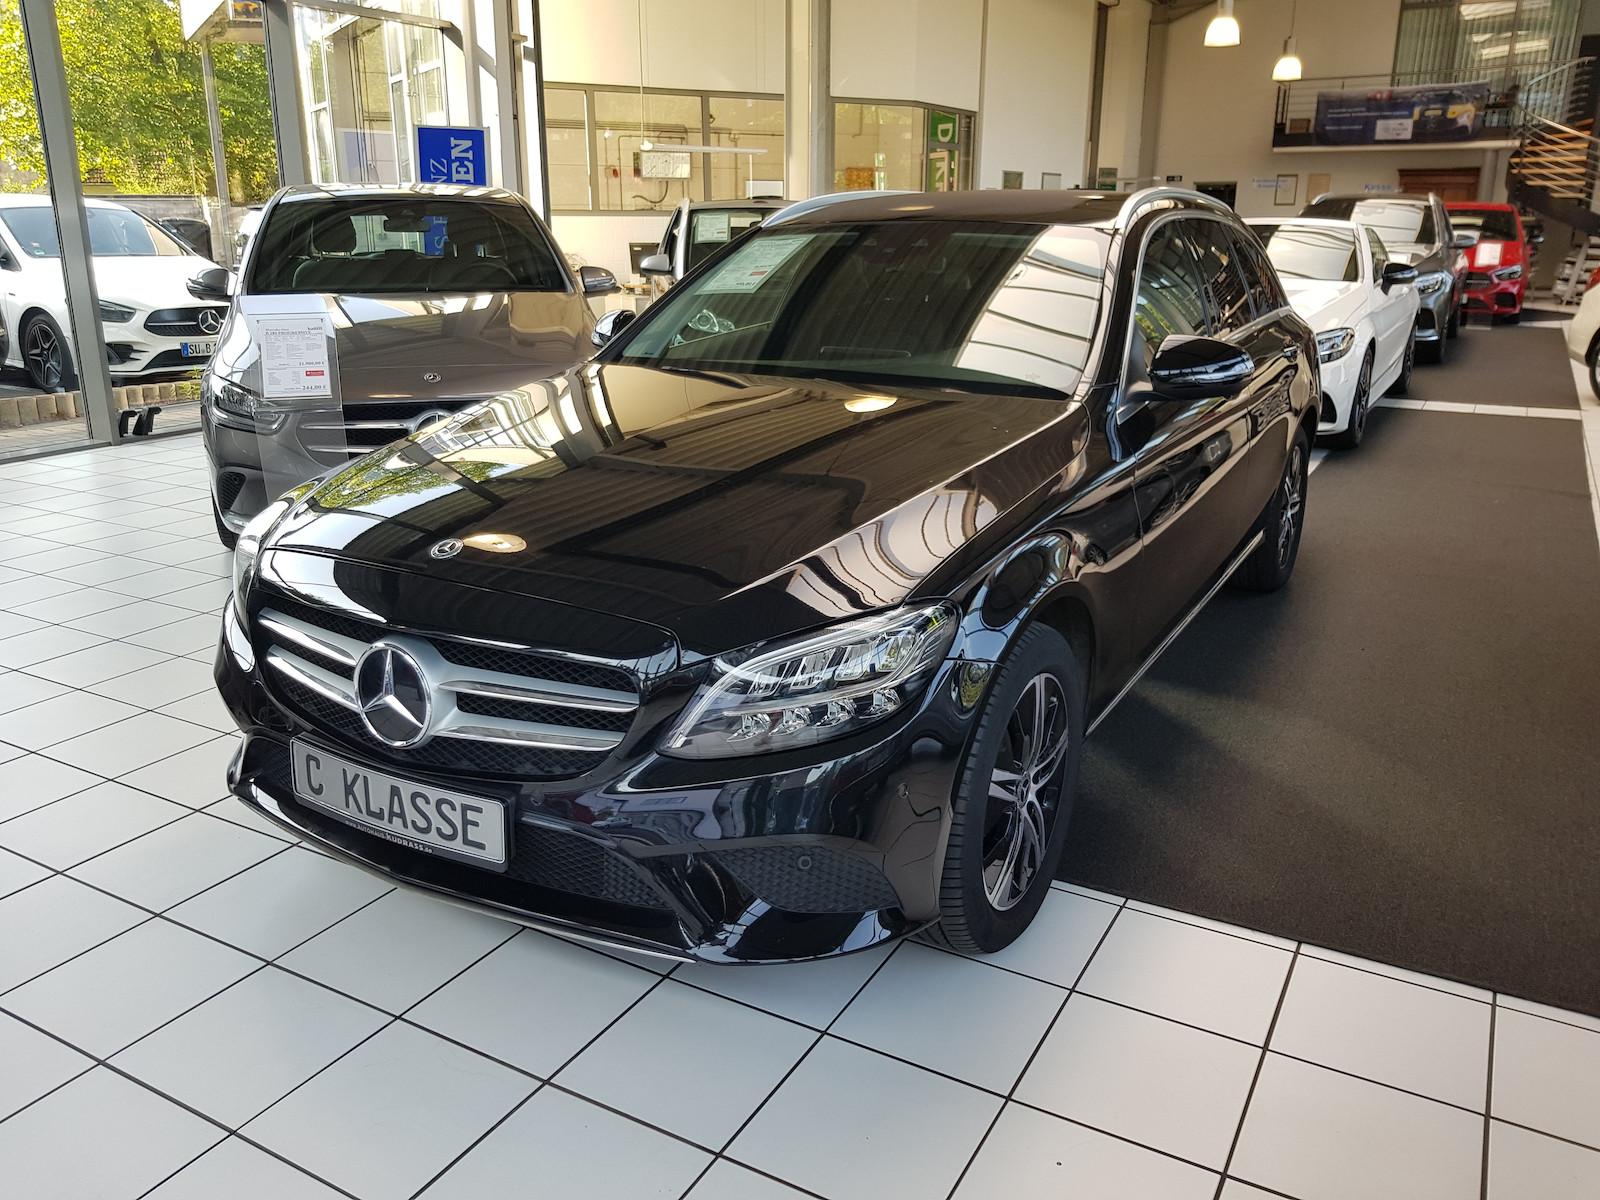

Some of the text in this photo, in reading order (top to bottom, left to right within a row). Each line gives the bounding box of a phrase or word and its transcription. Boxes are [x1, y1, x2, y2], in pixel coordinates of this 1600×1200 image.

[189, 343, 201, 354] SU
[305, 753, 486, 851] C KLASSE
